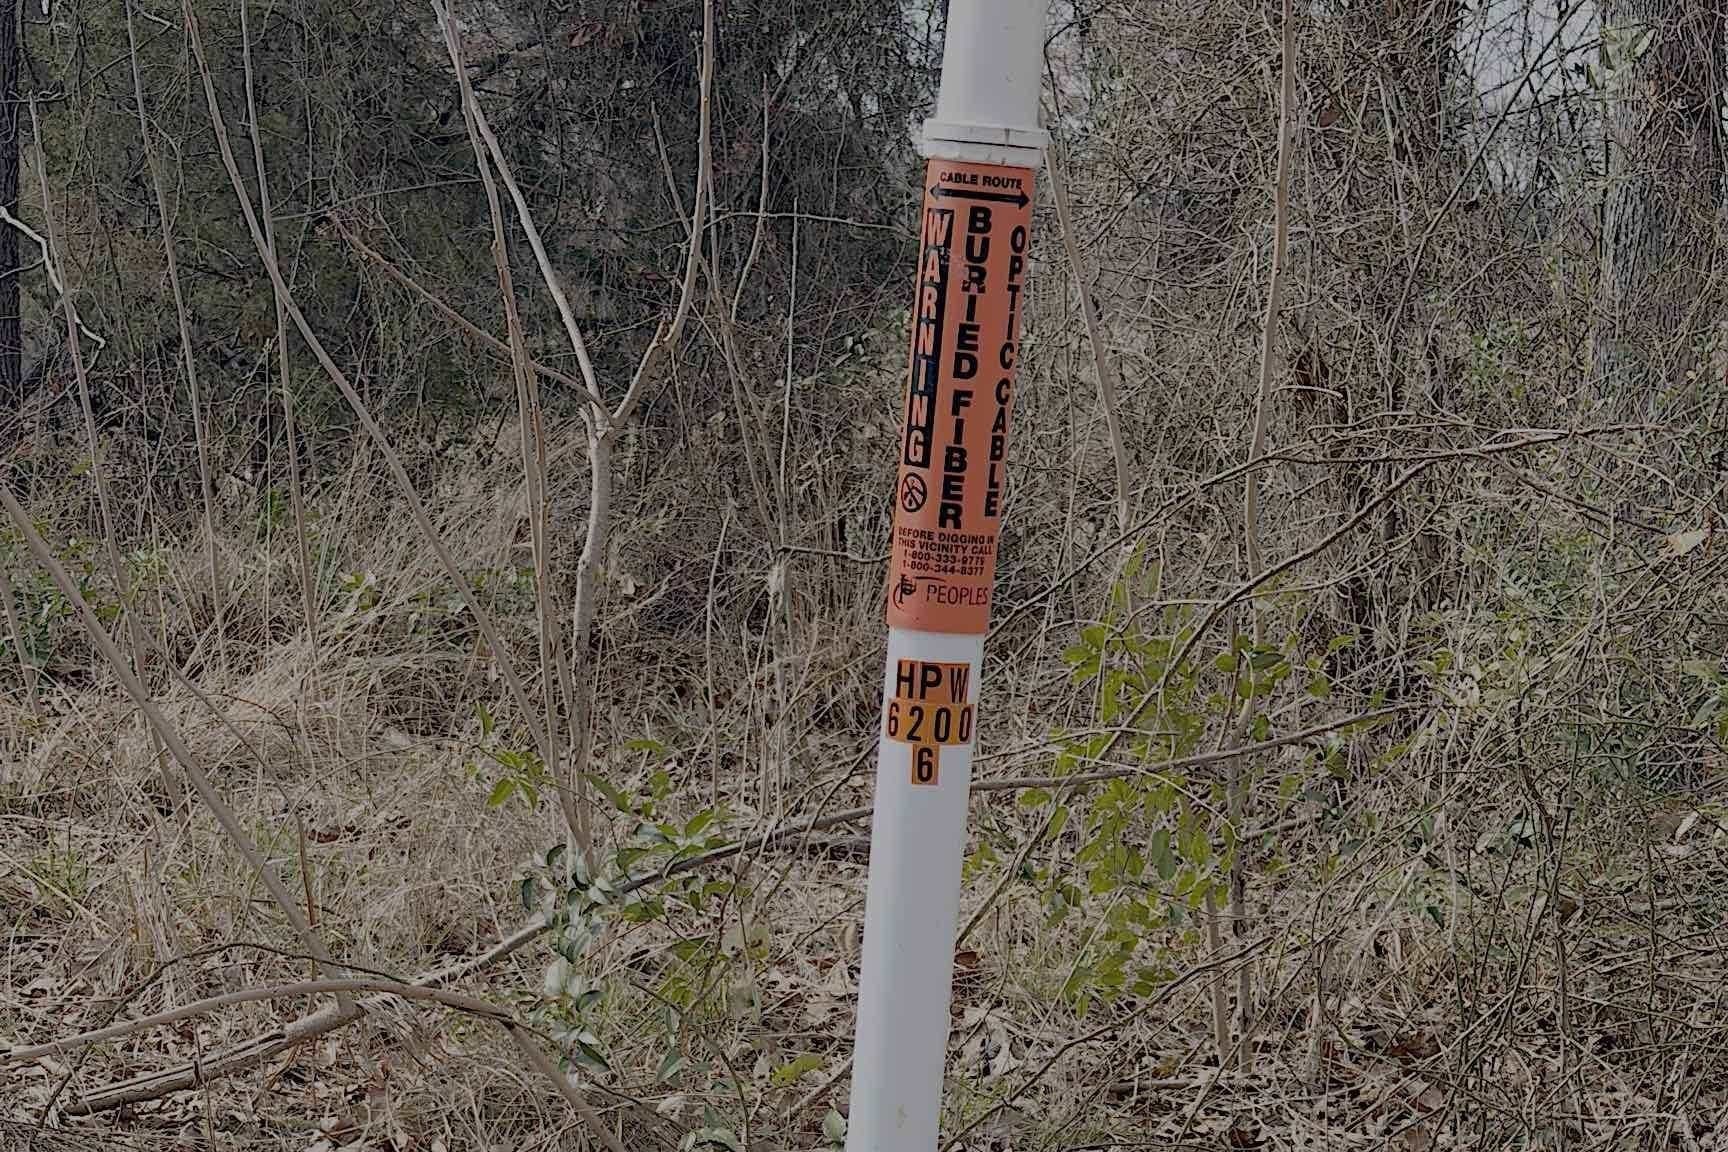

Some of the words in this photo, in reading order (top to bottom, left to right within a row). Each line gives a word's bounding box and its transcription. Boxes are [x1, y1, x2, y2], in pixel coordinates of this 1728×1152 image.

[940, 171, 978, 185] CABLE
[982, 174, 1023, 189] ROUTE
[953, 205, 993, 380] BURIED
[999, 225, 1027, 371] OPTIC
[907, 208, 951, 465] WARNING
[938, 389, 974, 530] FIBER
[984, 378, 1011, 517] CABLE
[898, 527, 935, 541] BEFORE
[939, 532, 985, 545] DIGGING
[987, 535, 995, 545] IN
[898, 537, 916, 549] THIS
[919, 540, 969, 554] VICINITY
[971, 545, 993, 555] CALL
[926, 584, 989, 606] PEOPLES
[896, 662, 970, 703] HPW
[888, 702, 971, 742] 6200
[917, 747, 933, 782] 6
